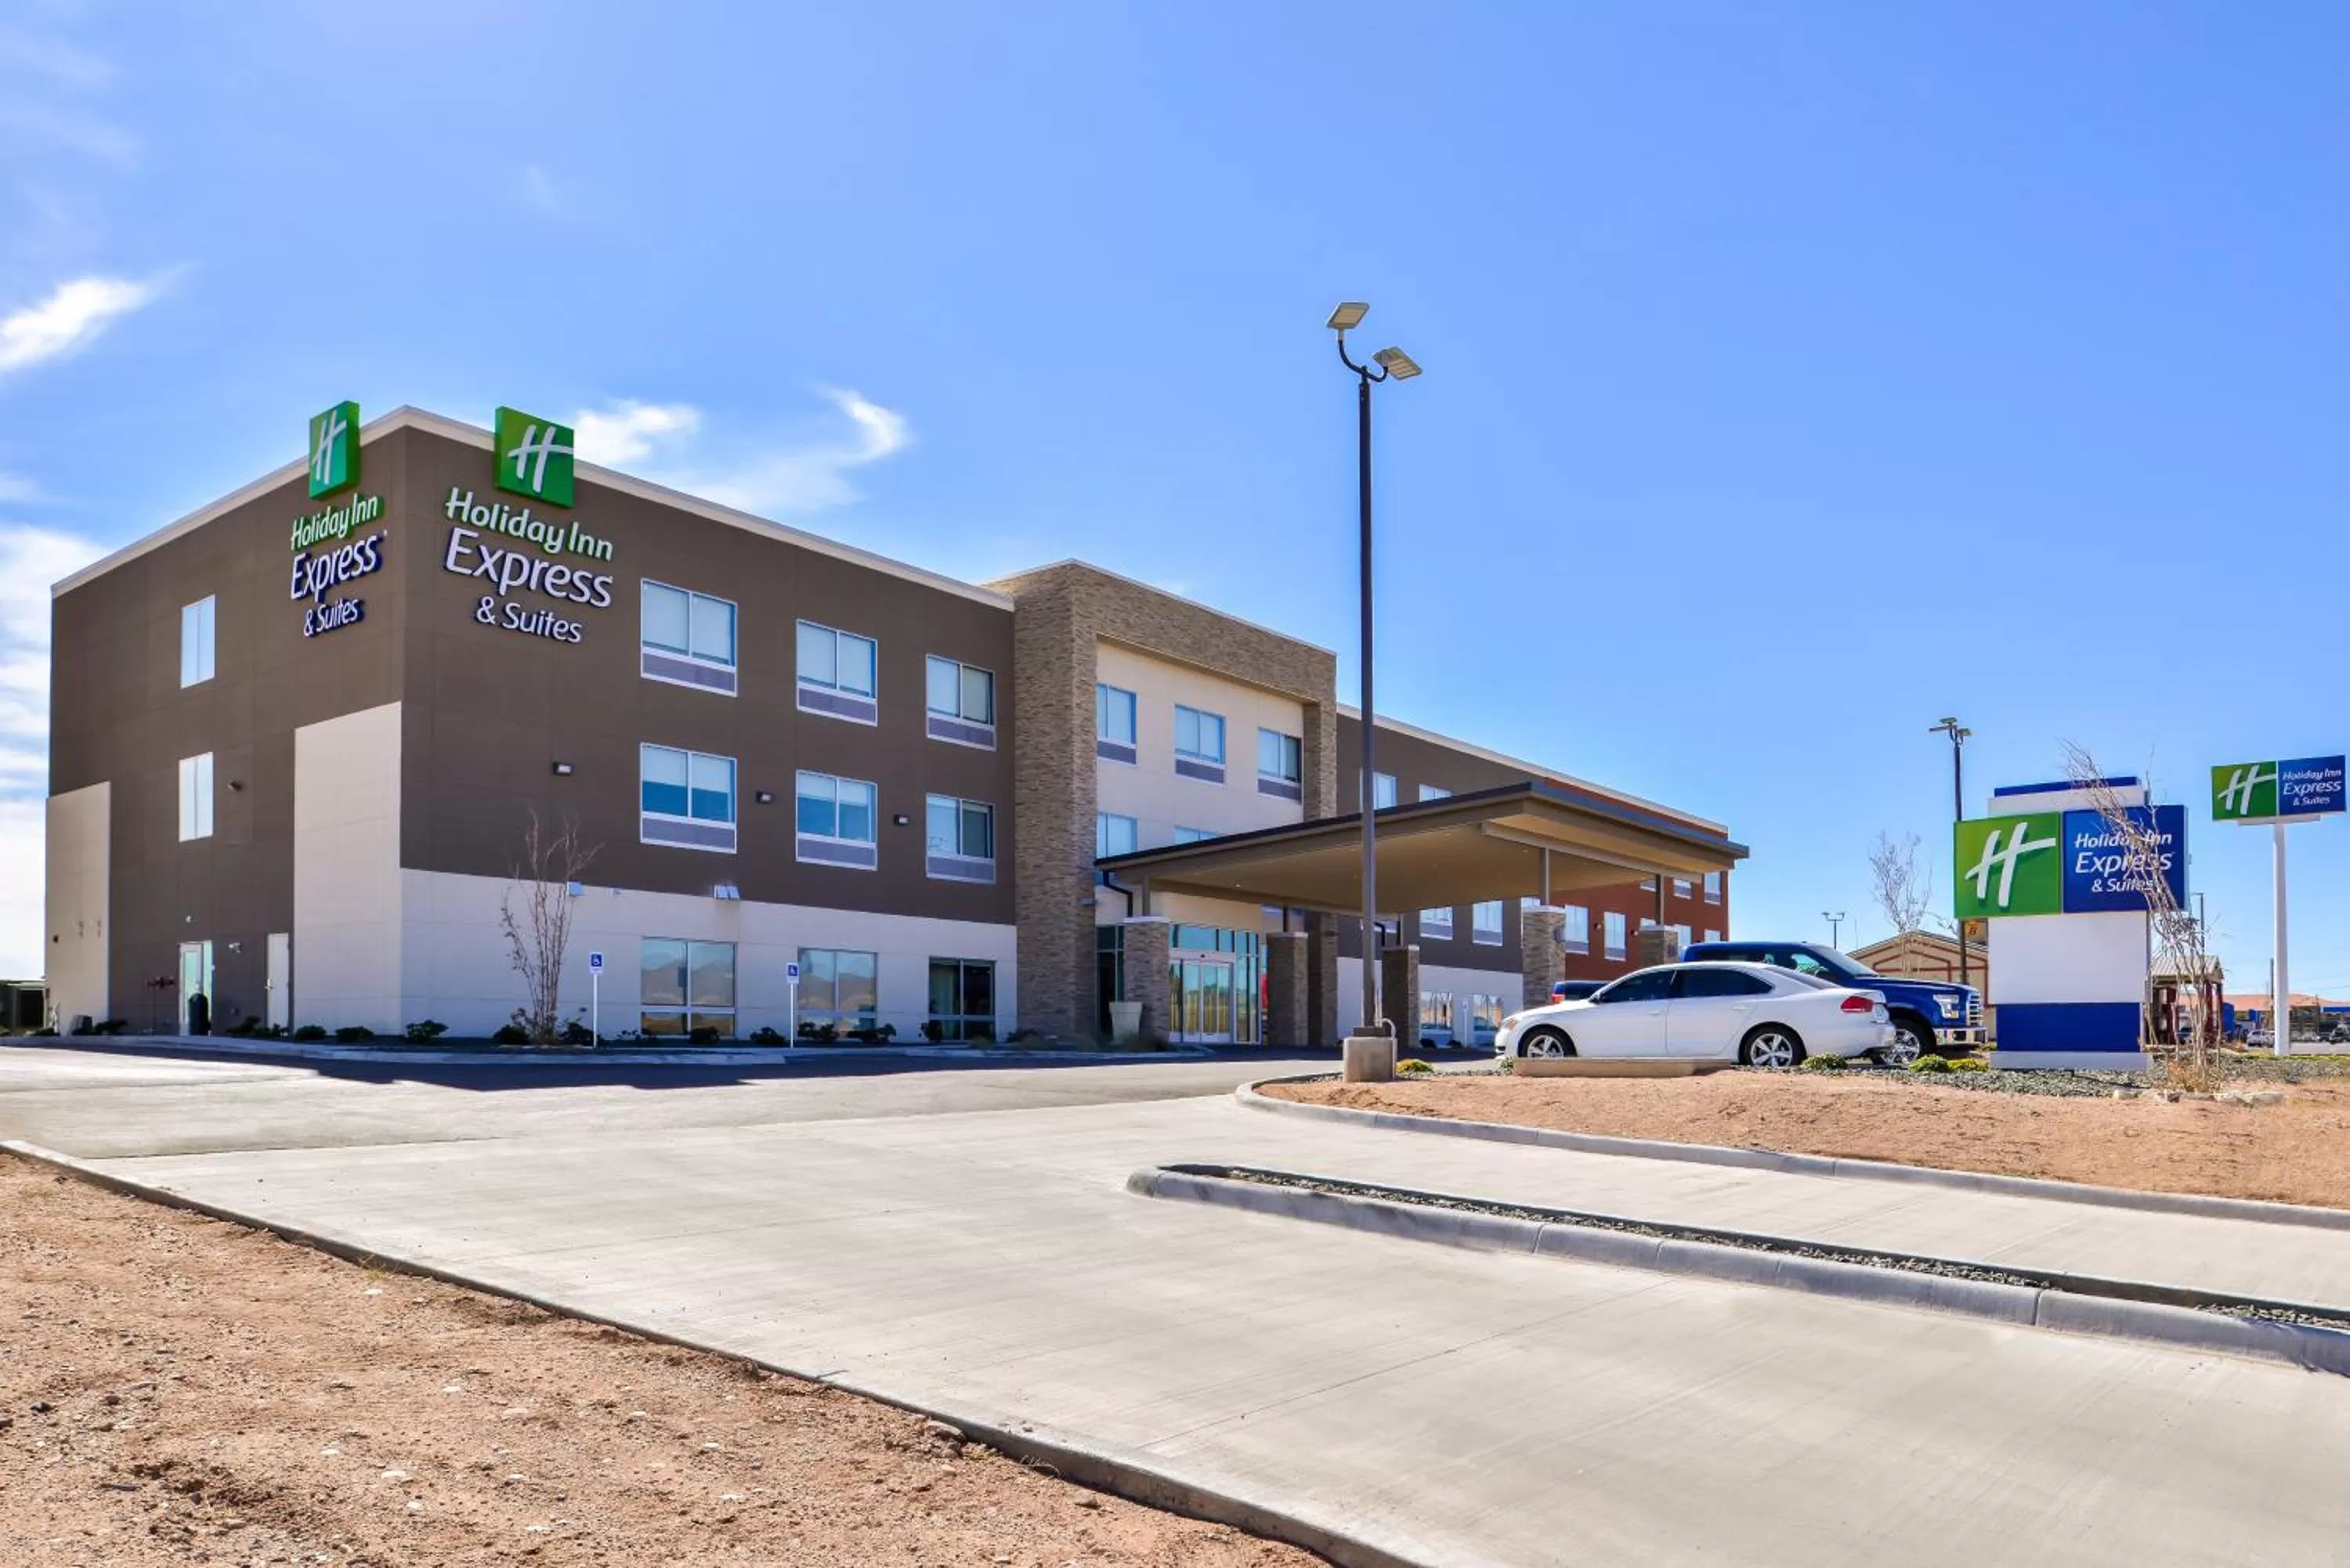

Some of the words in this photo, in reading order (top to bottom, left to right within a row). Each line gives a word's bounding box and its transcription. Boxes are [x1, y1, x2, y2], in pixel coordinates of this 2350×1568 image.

[291, 506, 349, 550] Holiday
[352, 493, 378, 525] Inn
[445, 486, 565, 554] Holiday
[569, 521, 613, 562] Inn
[291, 535, 378, 602] Express
[445, 527, 613, 608] Express
[303, 609, 314, 636] &
[316, 598, 359, 632] Suites
[475, 596, 495, 624] &
[502, 602, 582, 642] Suites
[2283, 770, 2323, 781] Holiday
[2324, 768, 2341, 778] Inn
[2283, 781, 2341, 796] Express
[2302, 796, 2330, 805] Suites
[2075, 831, 2138, 850] Holida
[2091, 878, 2103, 892] &
